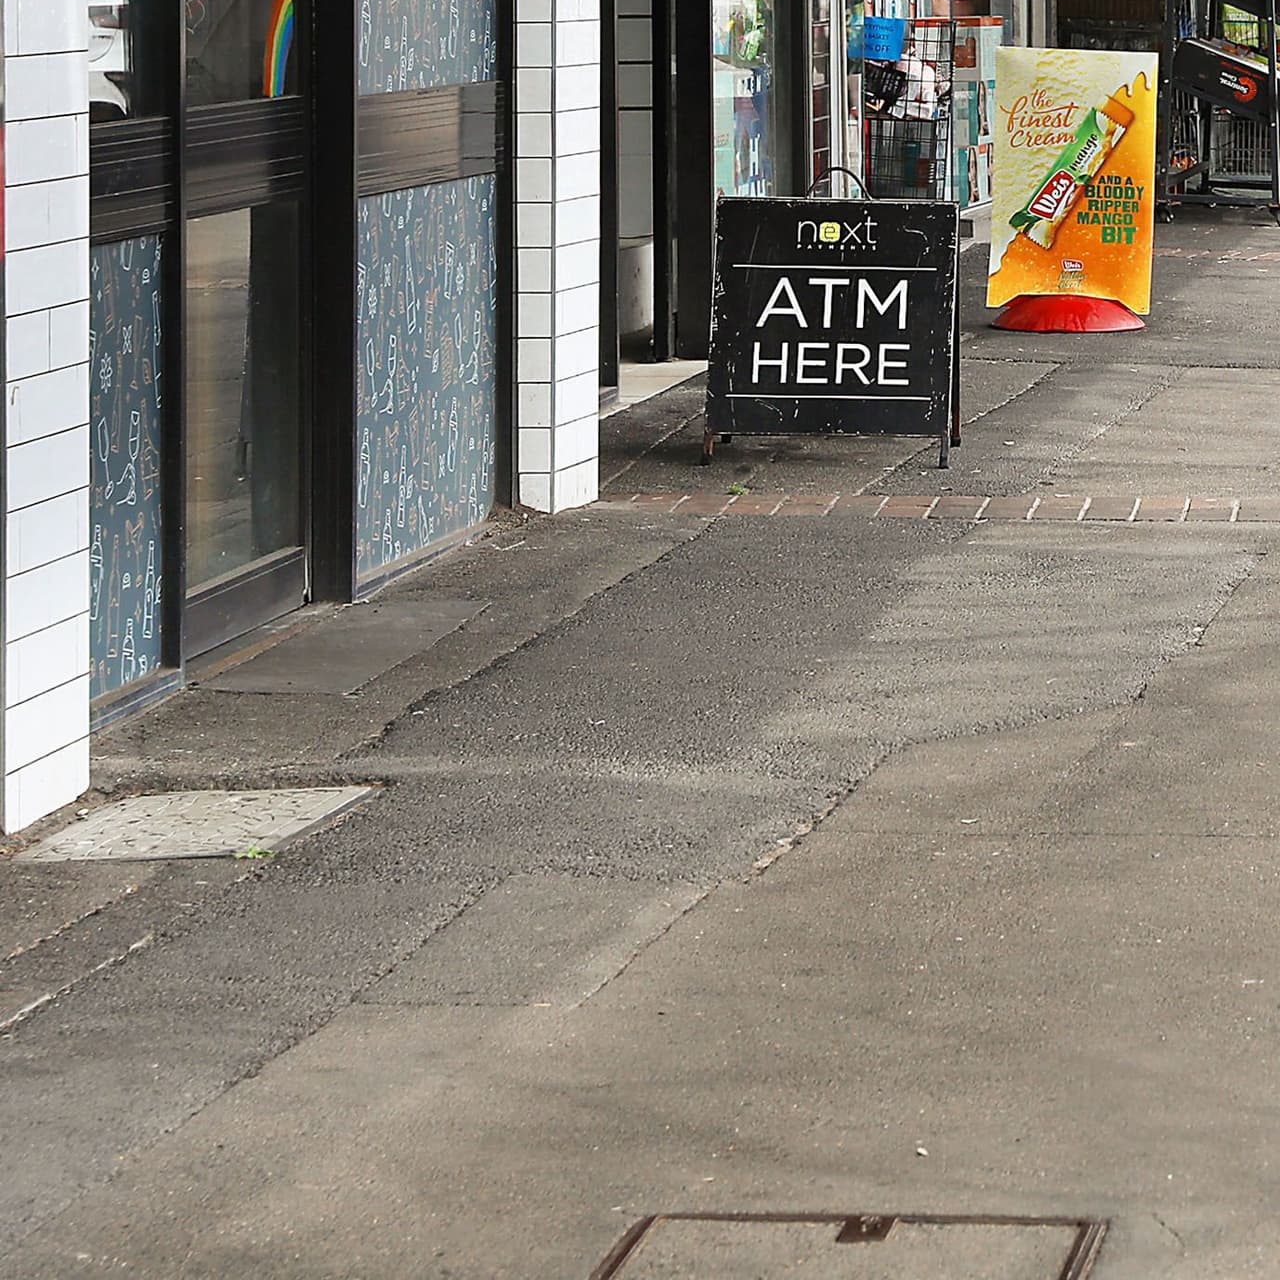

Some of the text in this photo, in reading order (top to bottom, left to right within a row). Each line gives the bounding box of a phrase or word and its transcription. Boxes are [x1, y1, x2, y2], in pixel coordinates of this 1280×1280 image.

[1030, 89, 1053, 108] the
[1000, 95, 1079, 133] finest
[1069, 133, 1098, 172] mango
[1099, 175, 1133, 185] AND A
[1084, 185, 1144, 200] BLOODY
[1088, 200, 1139, 213] RIPPER
[1077, 212, 1133, 225] MANGO
[797, 216, 878, 244] next
[1101, 228, 1137, 245] BIT
[755, 277, 908, 329] ATM
[751, 341, 911, 386] HERE
